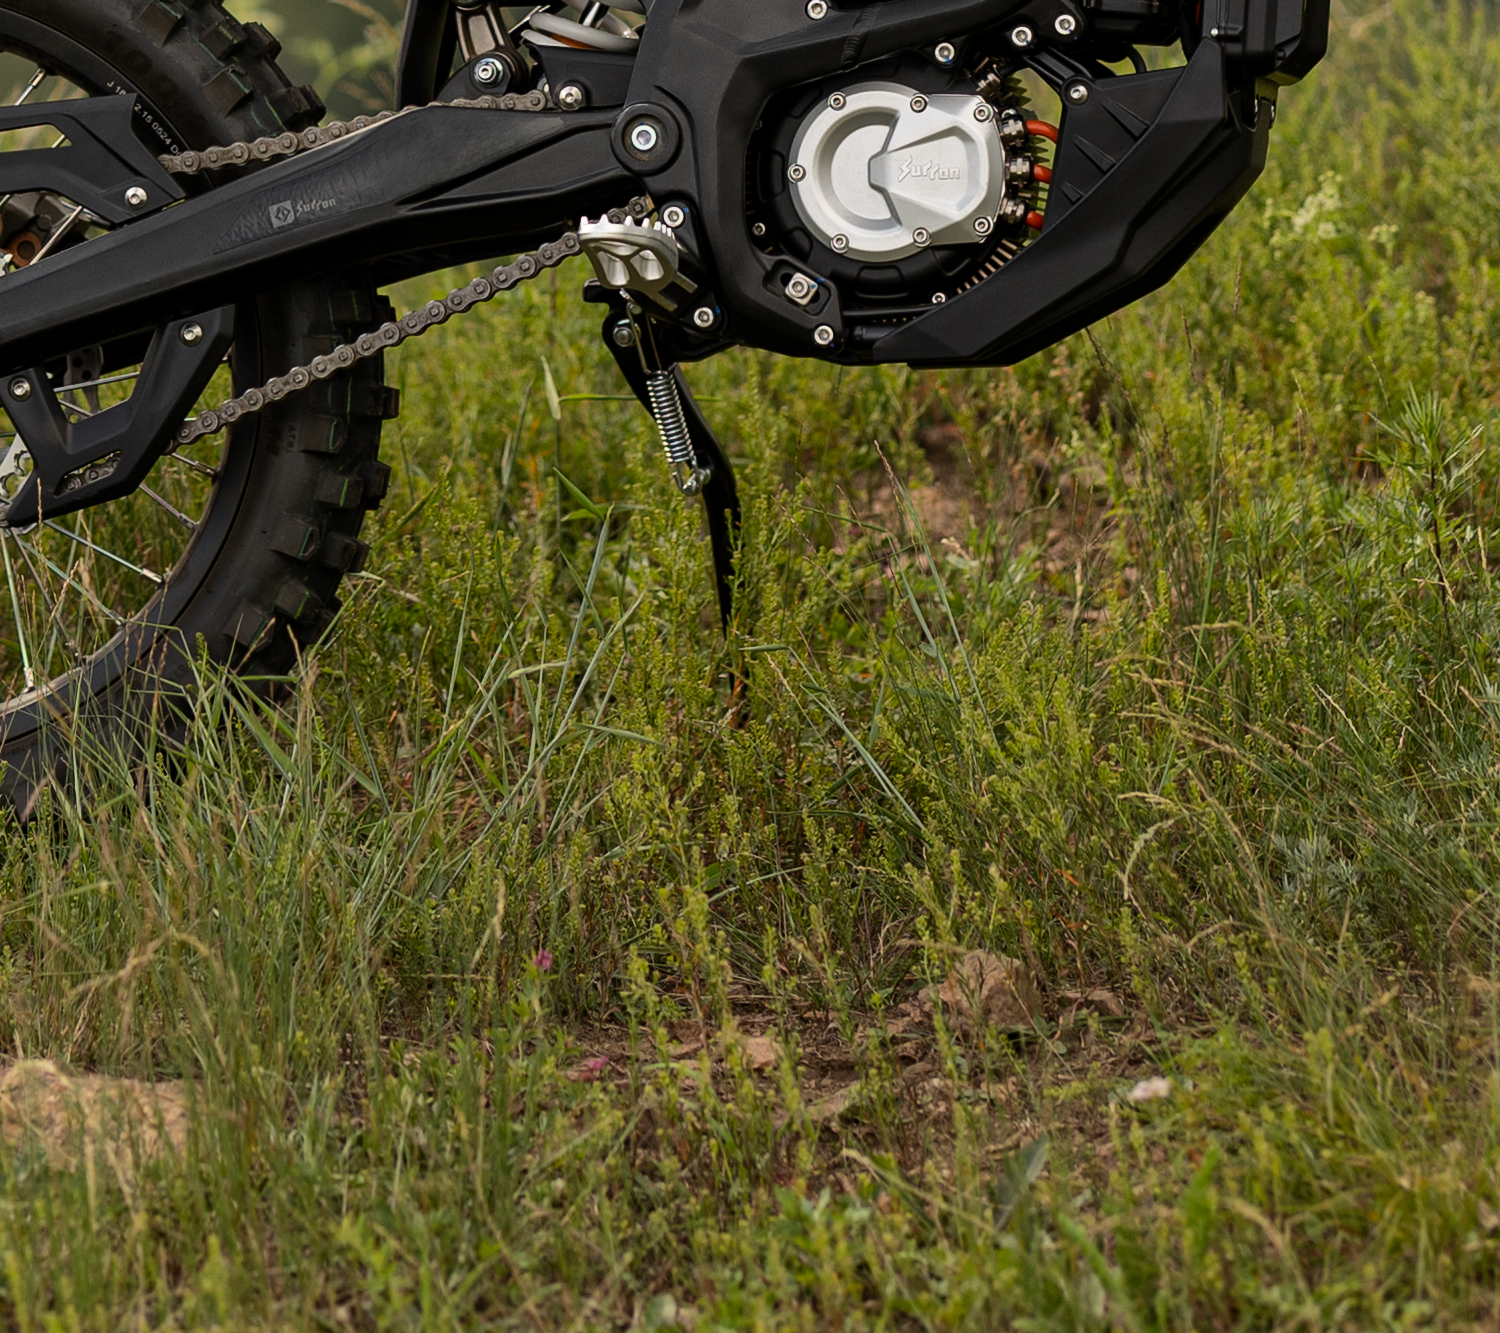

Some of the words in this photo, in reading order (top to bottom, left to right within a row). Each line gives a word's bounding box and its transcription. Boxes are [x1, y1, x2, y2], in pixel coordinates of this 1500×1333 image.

[151, 121, 172, 145] 0524
[898, 154, 961, 183] Surron
[296, 198, 337, 218] Surron
